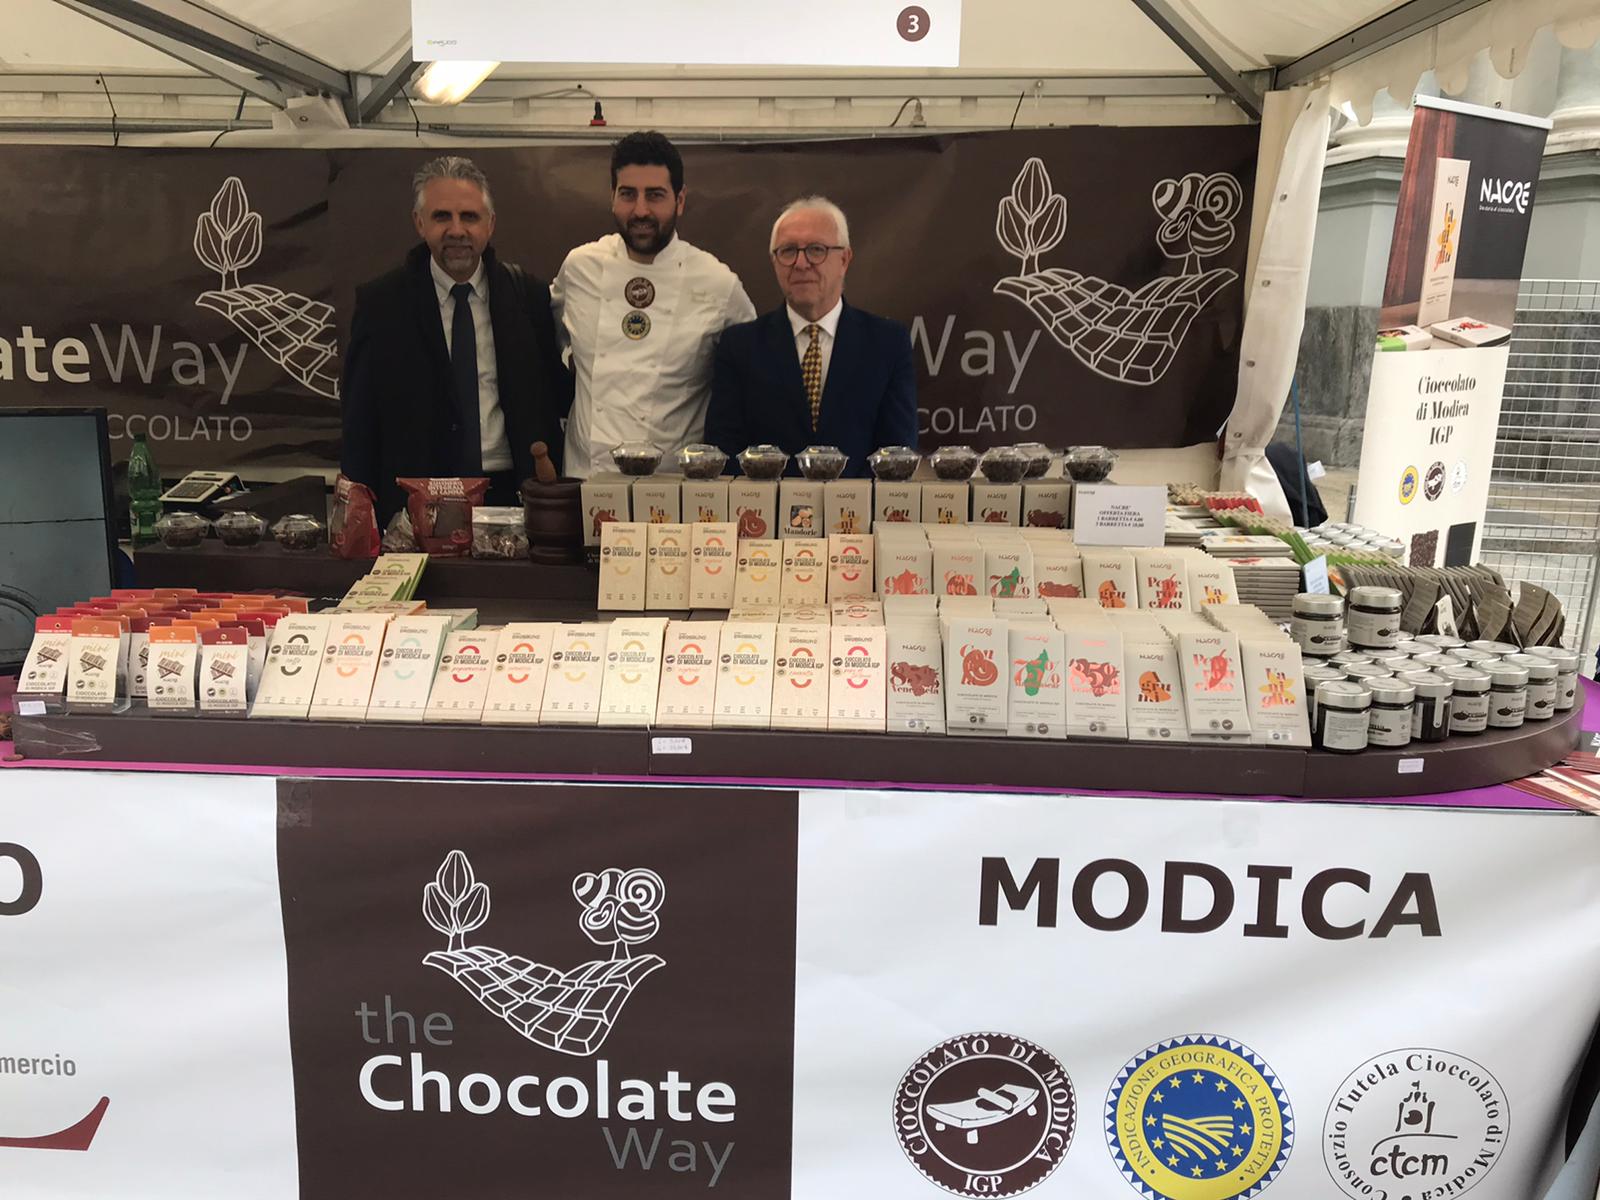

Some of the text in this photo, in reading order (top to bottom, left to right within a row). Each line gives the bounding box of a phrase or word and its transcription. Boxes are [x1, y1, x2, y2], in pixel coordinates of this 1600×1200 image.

[907, 14, 920, 33] 3
[1417, 373, 1477, 395] Cioccolato
[1416, 400, 1470, 421] di Modica
[1429, 426, 1454, 445] IGP
[978, 856, 1443, 941] MODICA
[355, 995, 454, 1046] the
[0, 1054, 77, 1077] mercio
[358, 1052, 737, 1122] Chocolate
[901, 1038, 1071, 1162] CIOCCOLATO DI MODICA
[1124, 1051, 1274, 1176] INDICAZIONE GEOGRAFICA PROTETTA
[1335, 1062, 1400, 1115] Tutela
[1405, 1053, 1500, 1119] Cioccolato
[1484, 1124, 1503, 1144] di
[601, 1126, 735, 1187] Way
[1370, 1144, 1449, 1179] ctcm
[964, 1174, 1003, 1192] IGP
